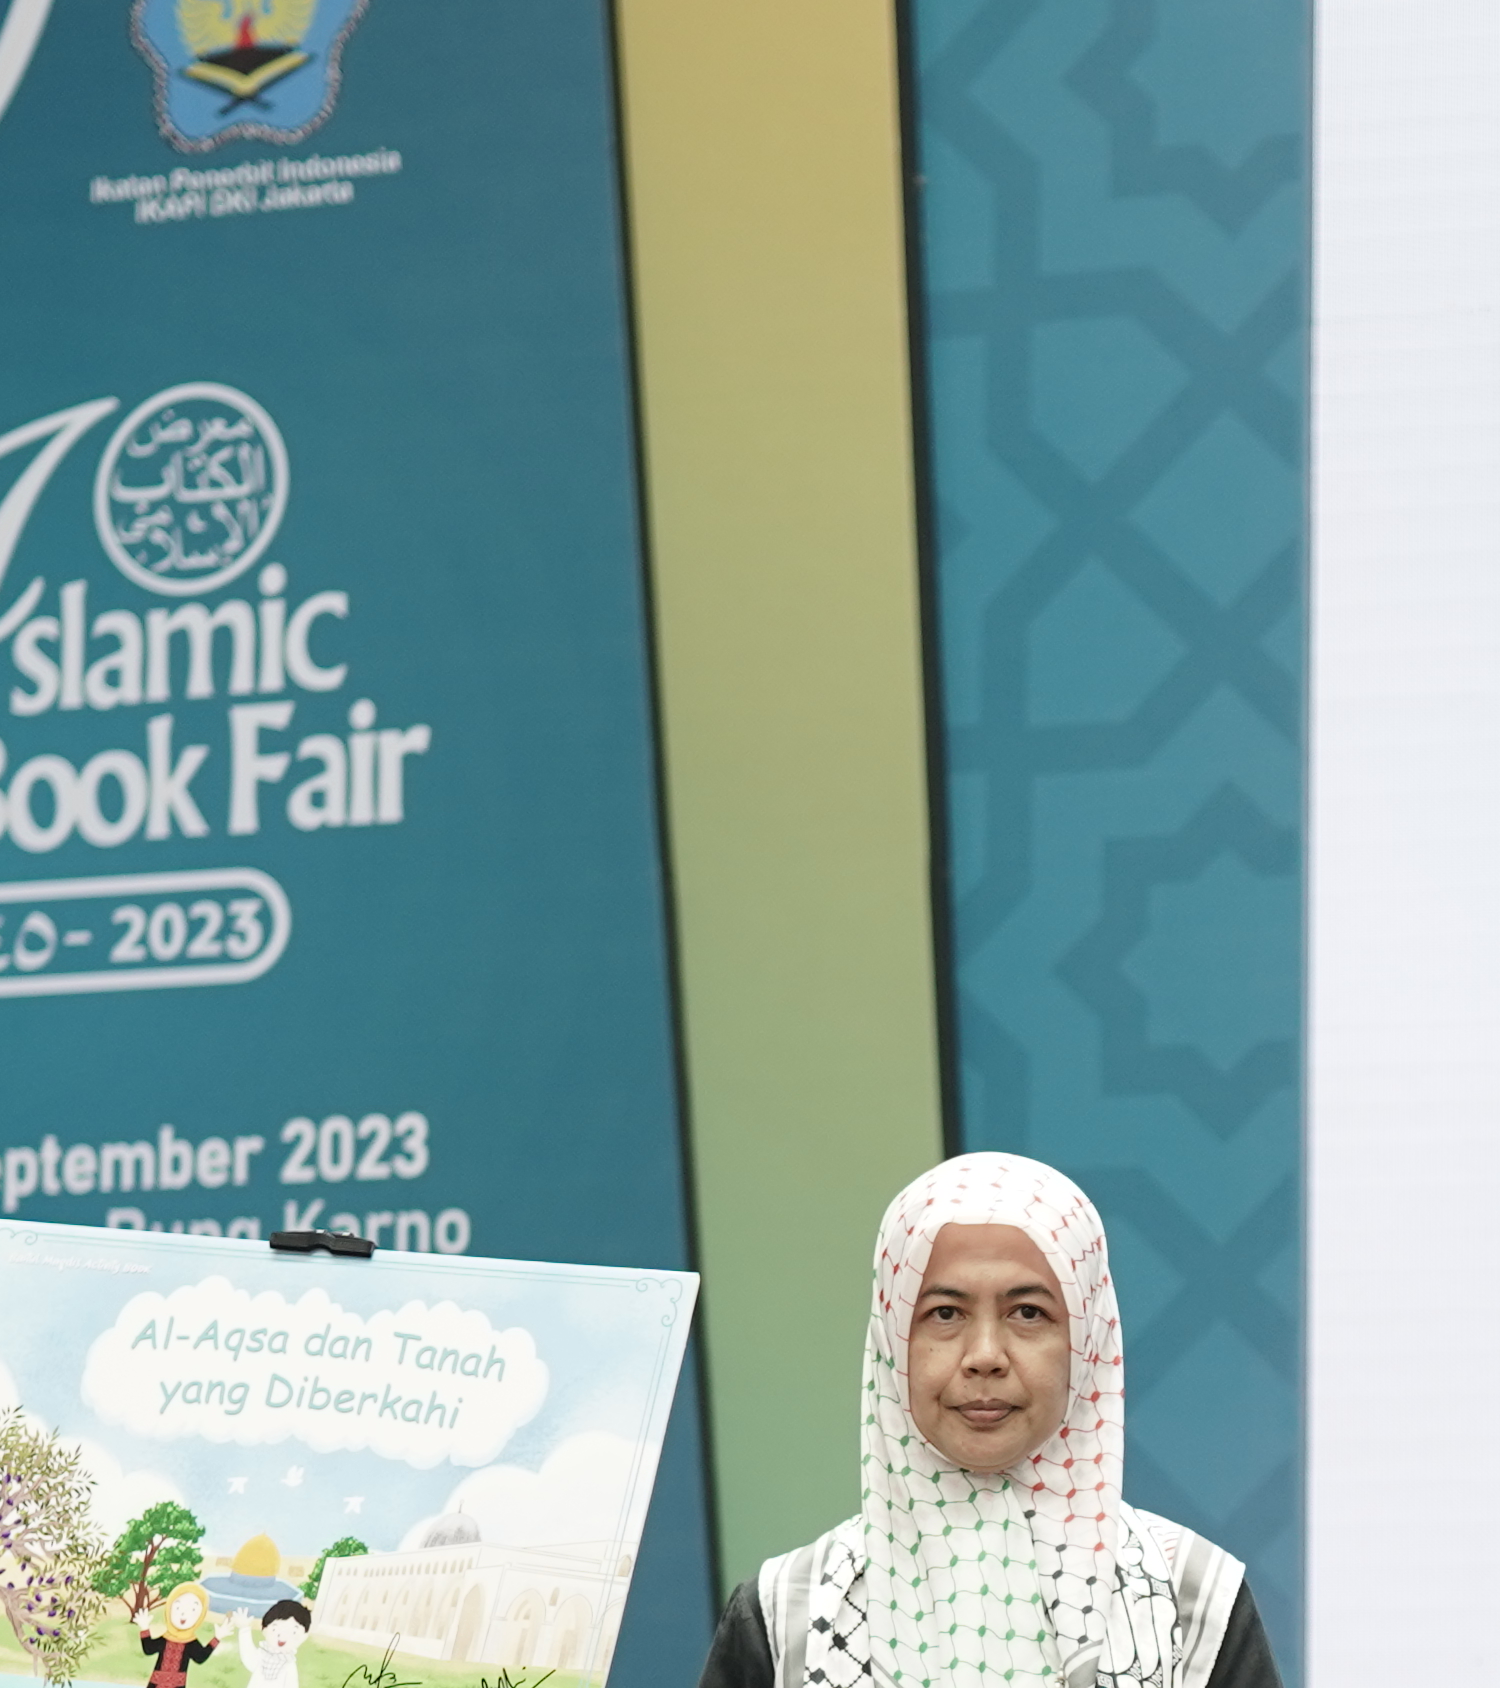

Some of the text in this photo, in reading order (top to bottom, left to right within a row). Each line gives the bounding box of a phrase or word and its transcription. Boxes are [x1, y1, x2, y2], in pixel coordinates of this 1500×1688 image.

[227, 697, 432, 836] Fair
[109, 897, 265, 963] 2023
[279, 1111, 431, 1186] 2023
[132, 1315, 506, 1383] Al-Aqsa dan Tanah
[159, 1373, 464, 1430] yang Diberkahi
